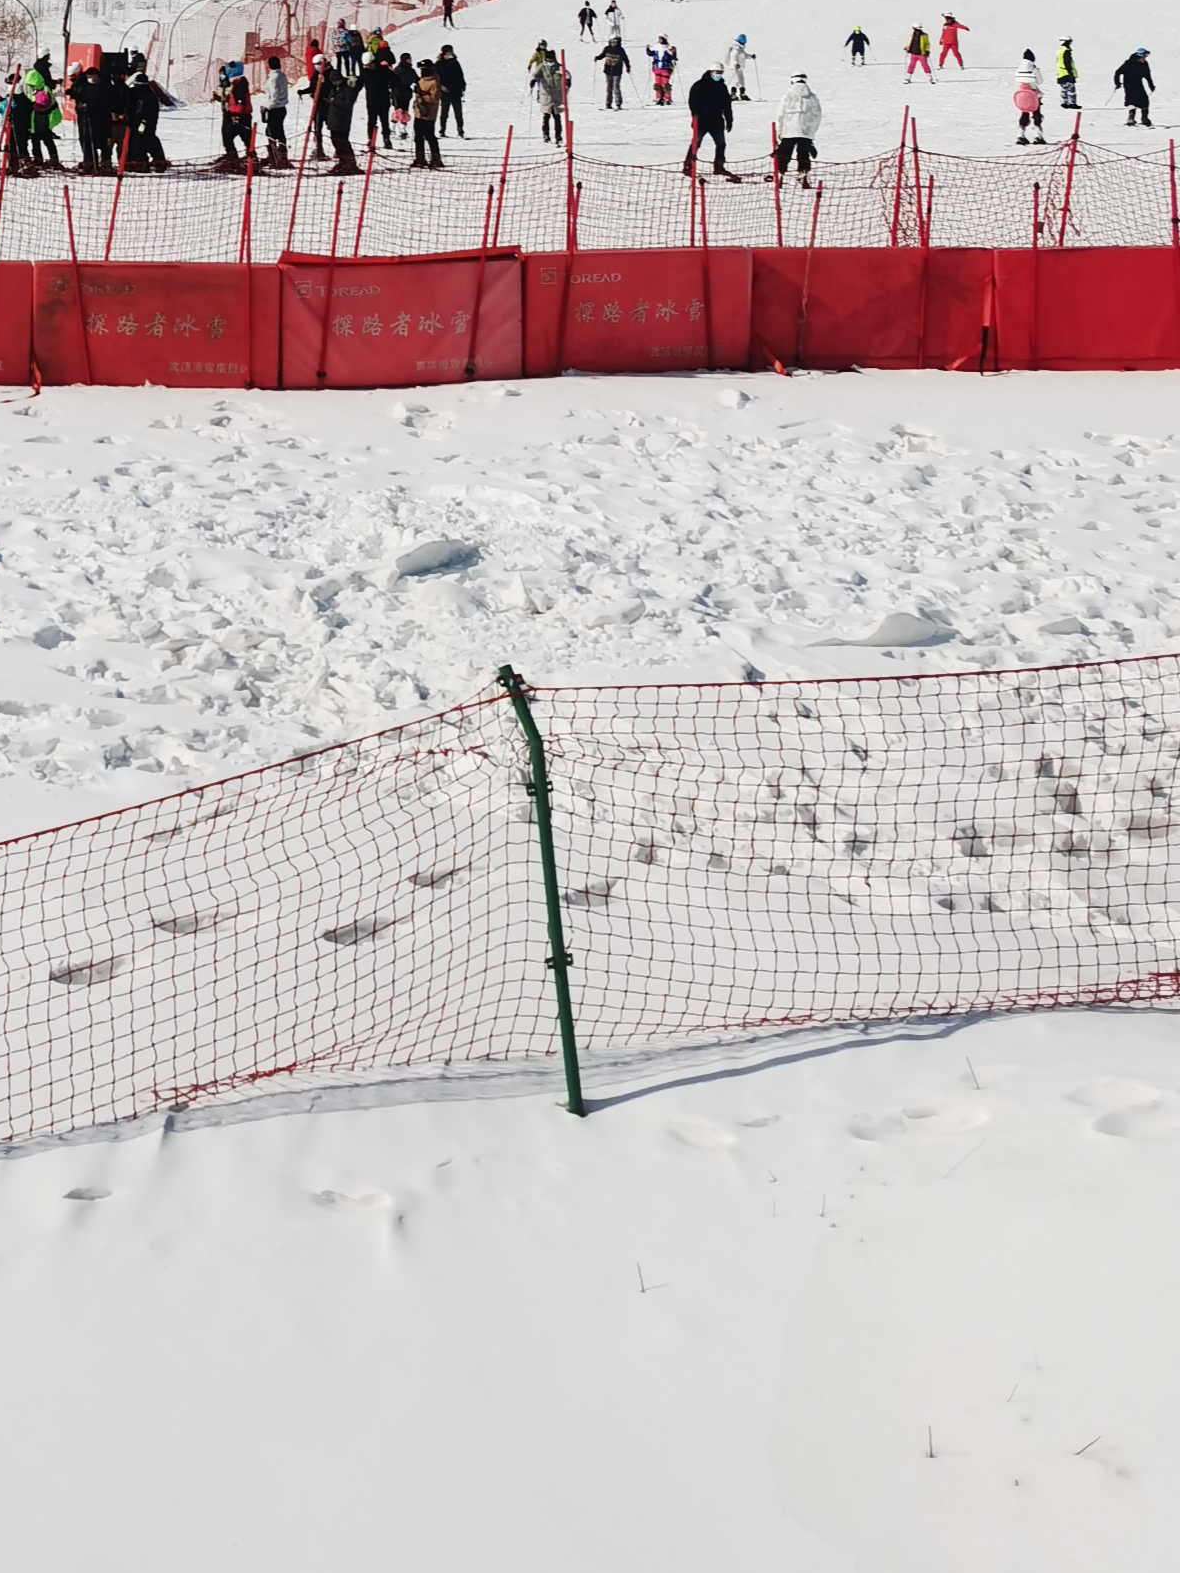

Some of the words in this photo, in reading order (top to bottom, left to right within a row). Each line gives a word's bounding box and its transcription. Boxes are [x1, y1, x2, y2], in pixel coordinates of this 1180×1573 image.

[332, 309, 471, 337] 探路者冰雪
[573, 297, 705, 324] 探路者冰雪
[86, 312, 227, 339] 探路者冰雪
